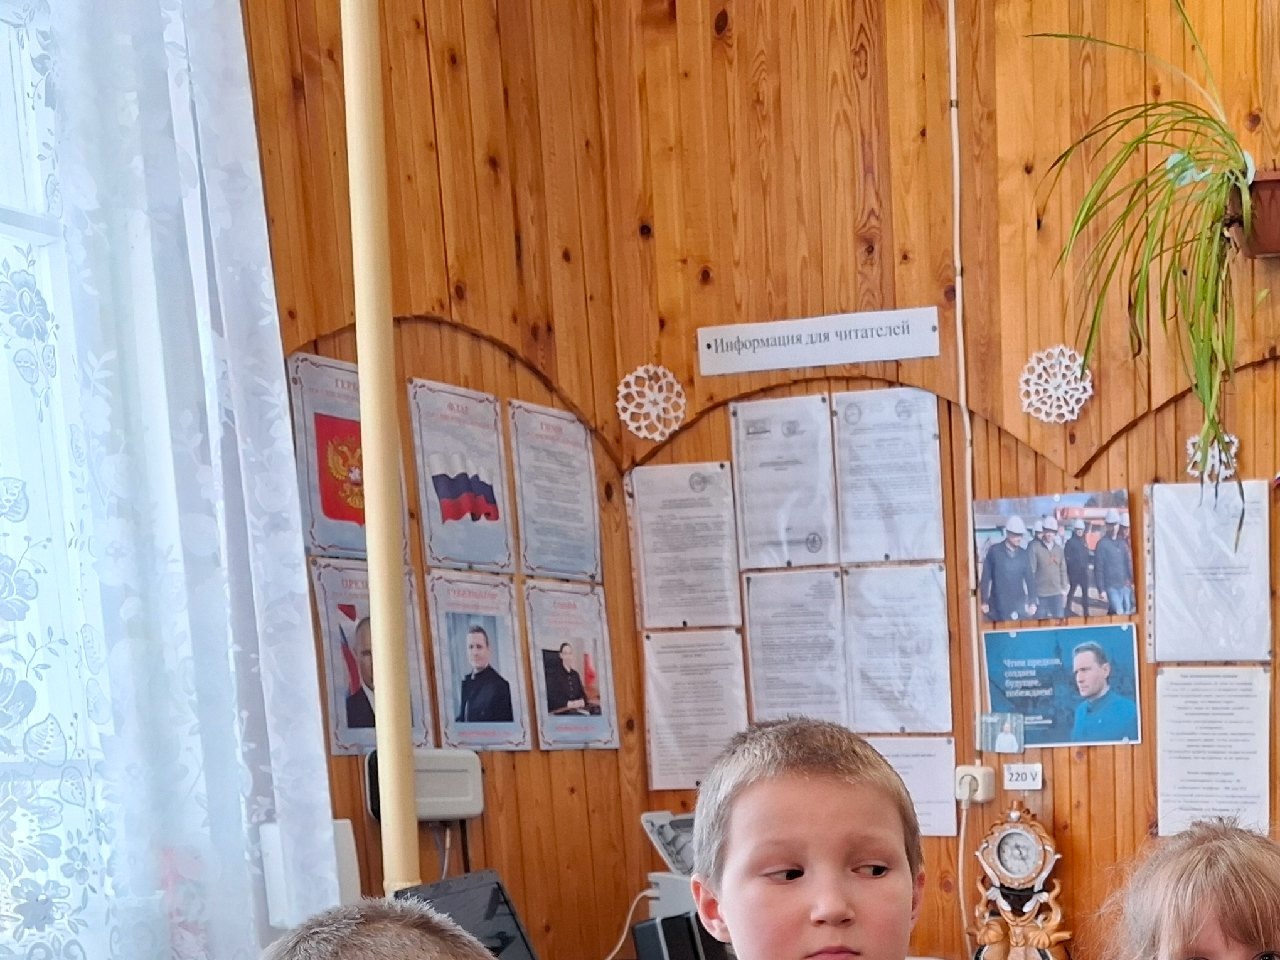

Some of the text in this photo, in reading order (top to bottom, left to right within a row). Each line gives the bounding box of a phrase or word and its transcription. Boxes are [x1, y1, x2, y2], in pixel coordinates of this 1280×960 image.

[714, 320, 911, 356] Информация для читателей
[1008, 771, 1038, 782] 220 V
